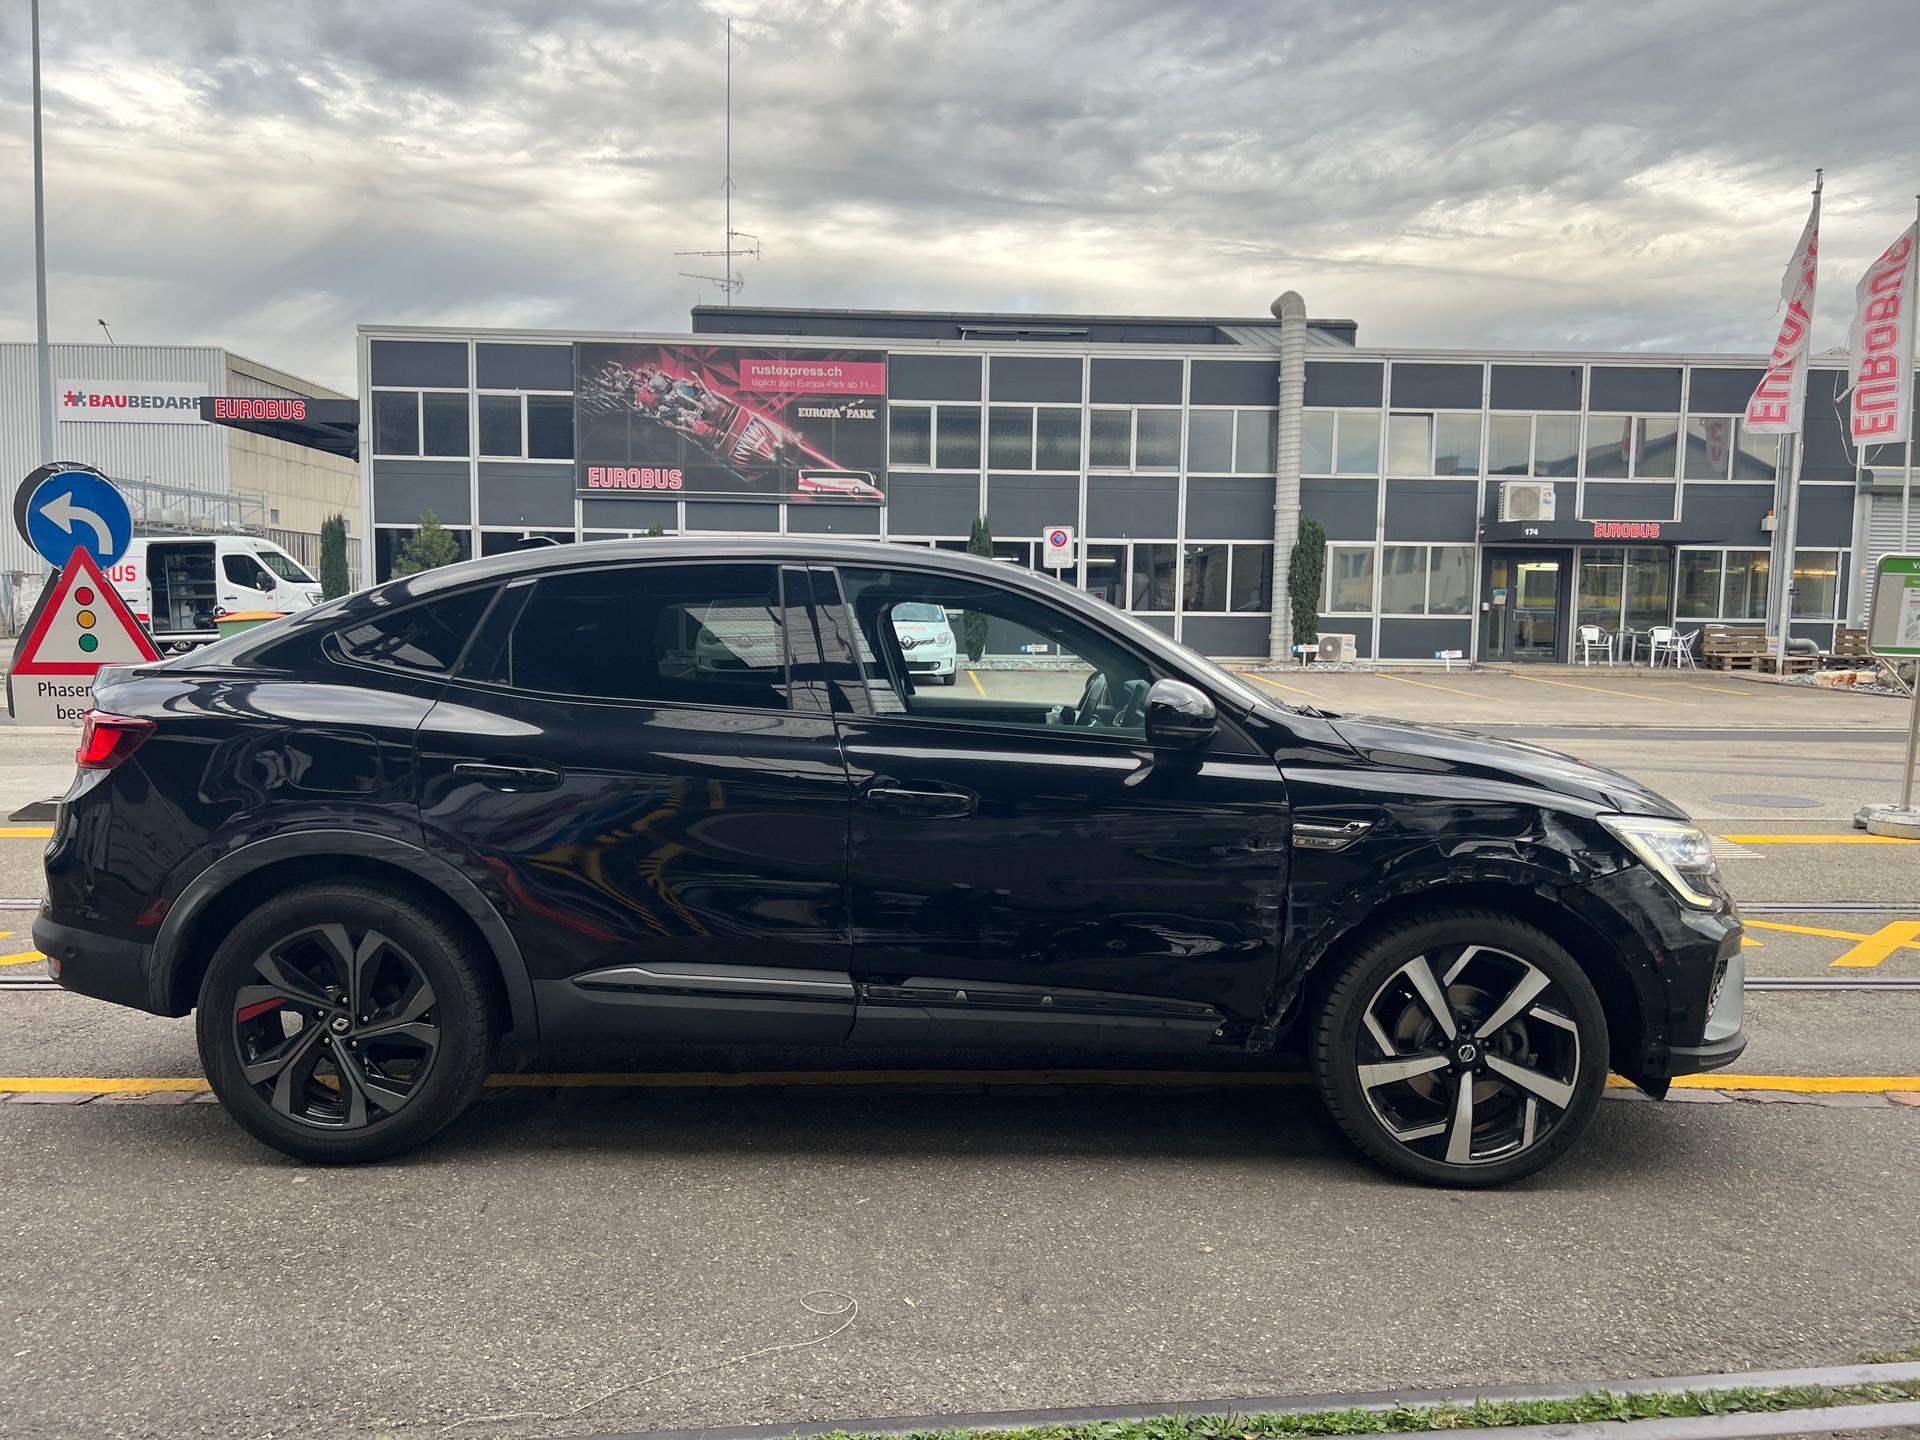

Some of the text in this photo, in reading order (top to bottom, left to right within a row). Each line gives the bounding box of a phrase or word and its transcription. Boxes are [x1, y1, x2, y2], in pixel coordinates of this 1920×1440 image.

[751, 365, 842, 378] rustexpress.ch
[751, 379, 777, 388] täglich
[797, 380, 846, 389] Europa-Park
[847, 381, 857, 389] ab
[215, 398, 306, 420] EUROBUS
[798, 407, 876, 419] EUROPA PARK
[588, 467, 682, 489] EUROBUS
[1593, 522, 1660, 538] EUROBUS
